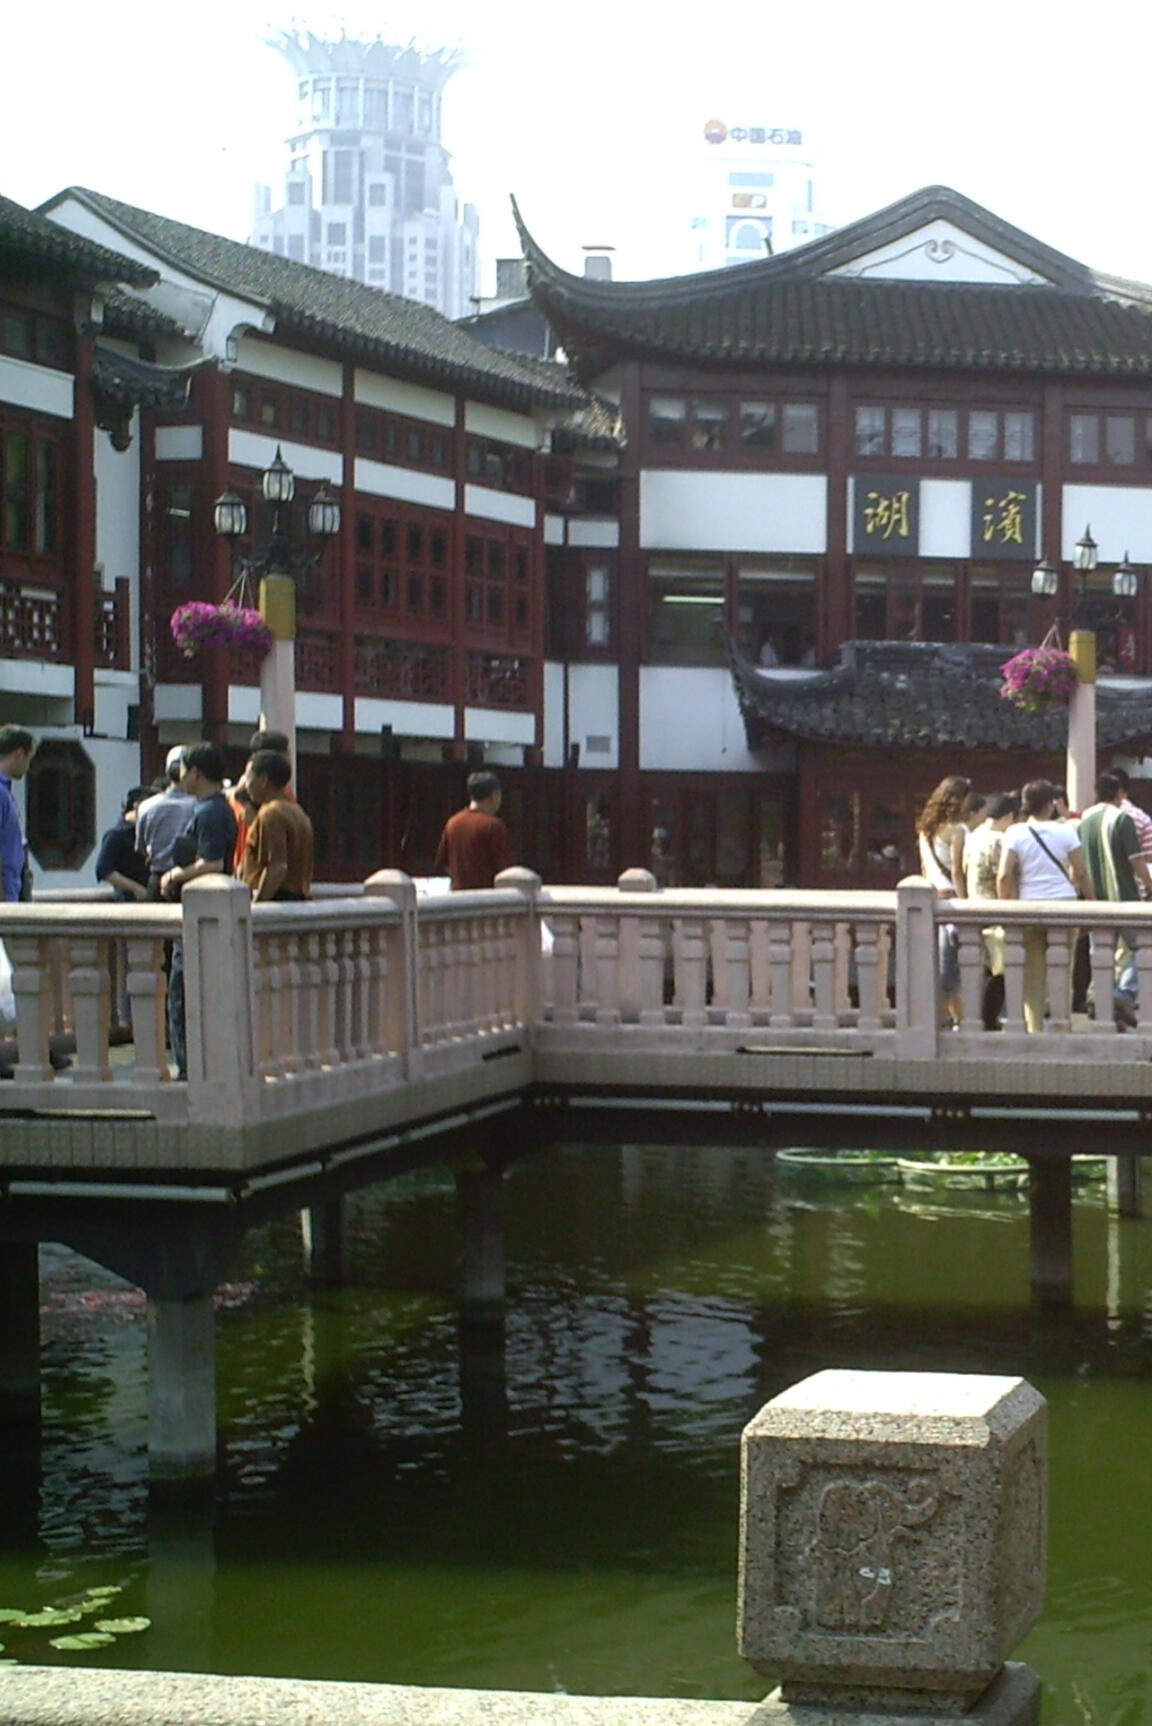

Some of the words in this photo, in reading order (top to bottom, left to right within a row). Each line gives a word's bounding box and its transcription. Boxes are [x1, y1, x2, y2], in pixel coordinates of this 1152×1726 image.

[730, 126, 803, 146] 中国石油
[863, 491, 911, 541] 湖
